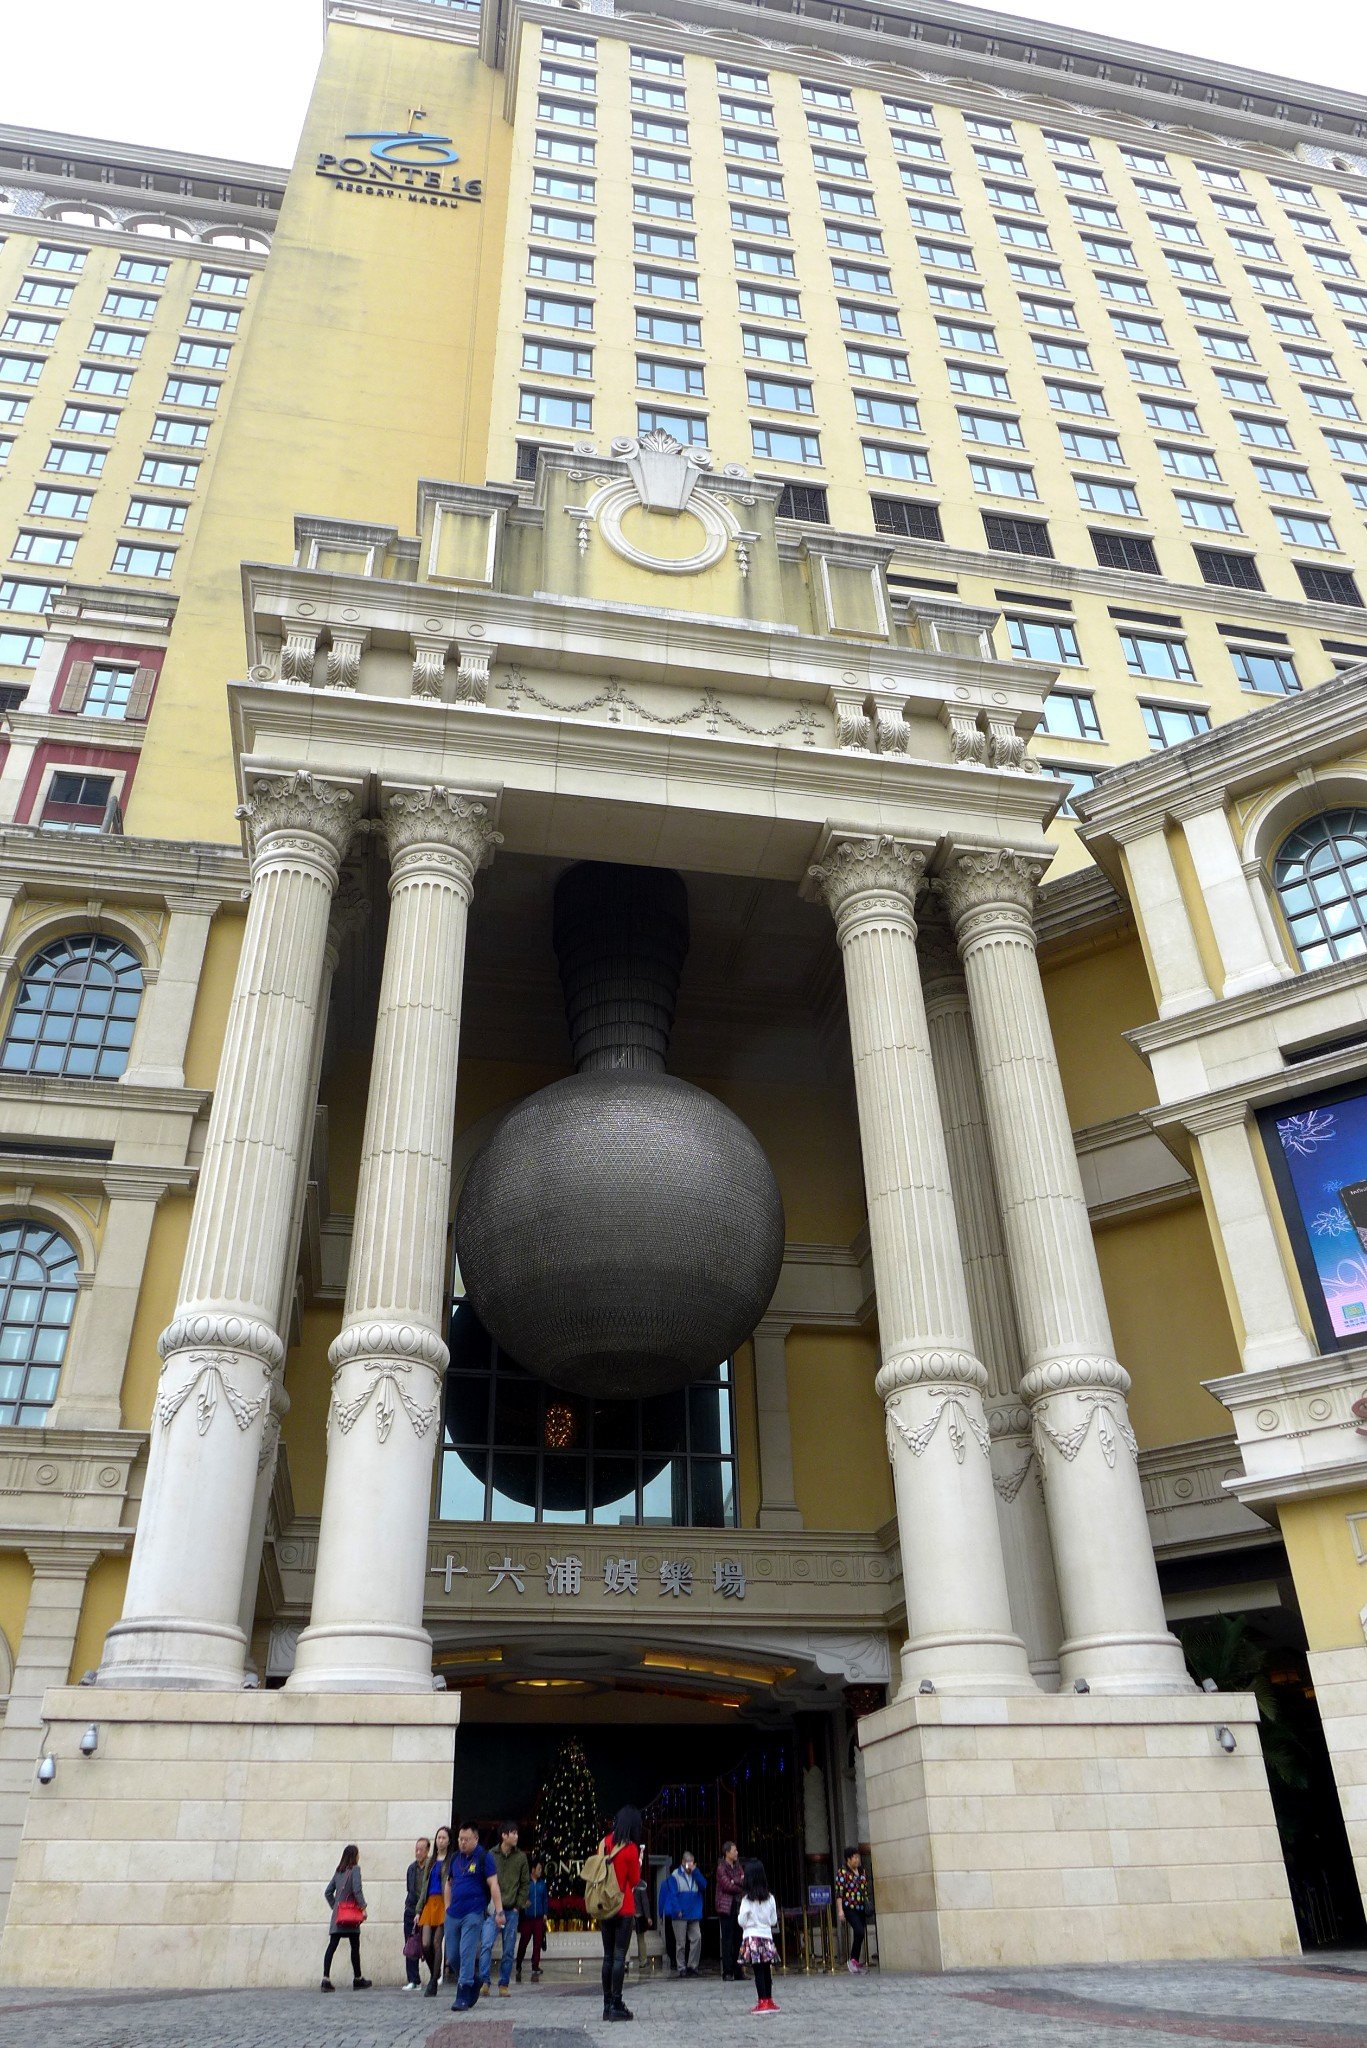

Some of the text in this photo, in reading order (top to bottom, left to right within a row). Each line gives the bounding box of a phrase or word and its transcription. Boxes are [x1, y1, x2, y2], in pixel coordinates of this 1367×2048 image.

[317, 153, 482, 195] PONTE 16
[335, 181, 458, 209] RESORT MACAU
